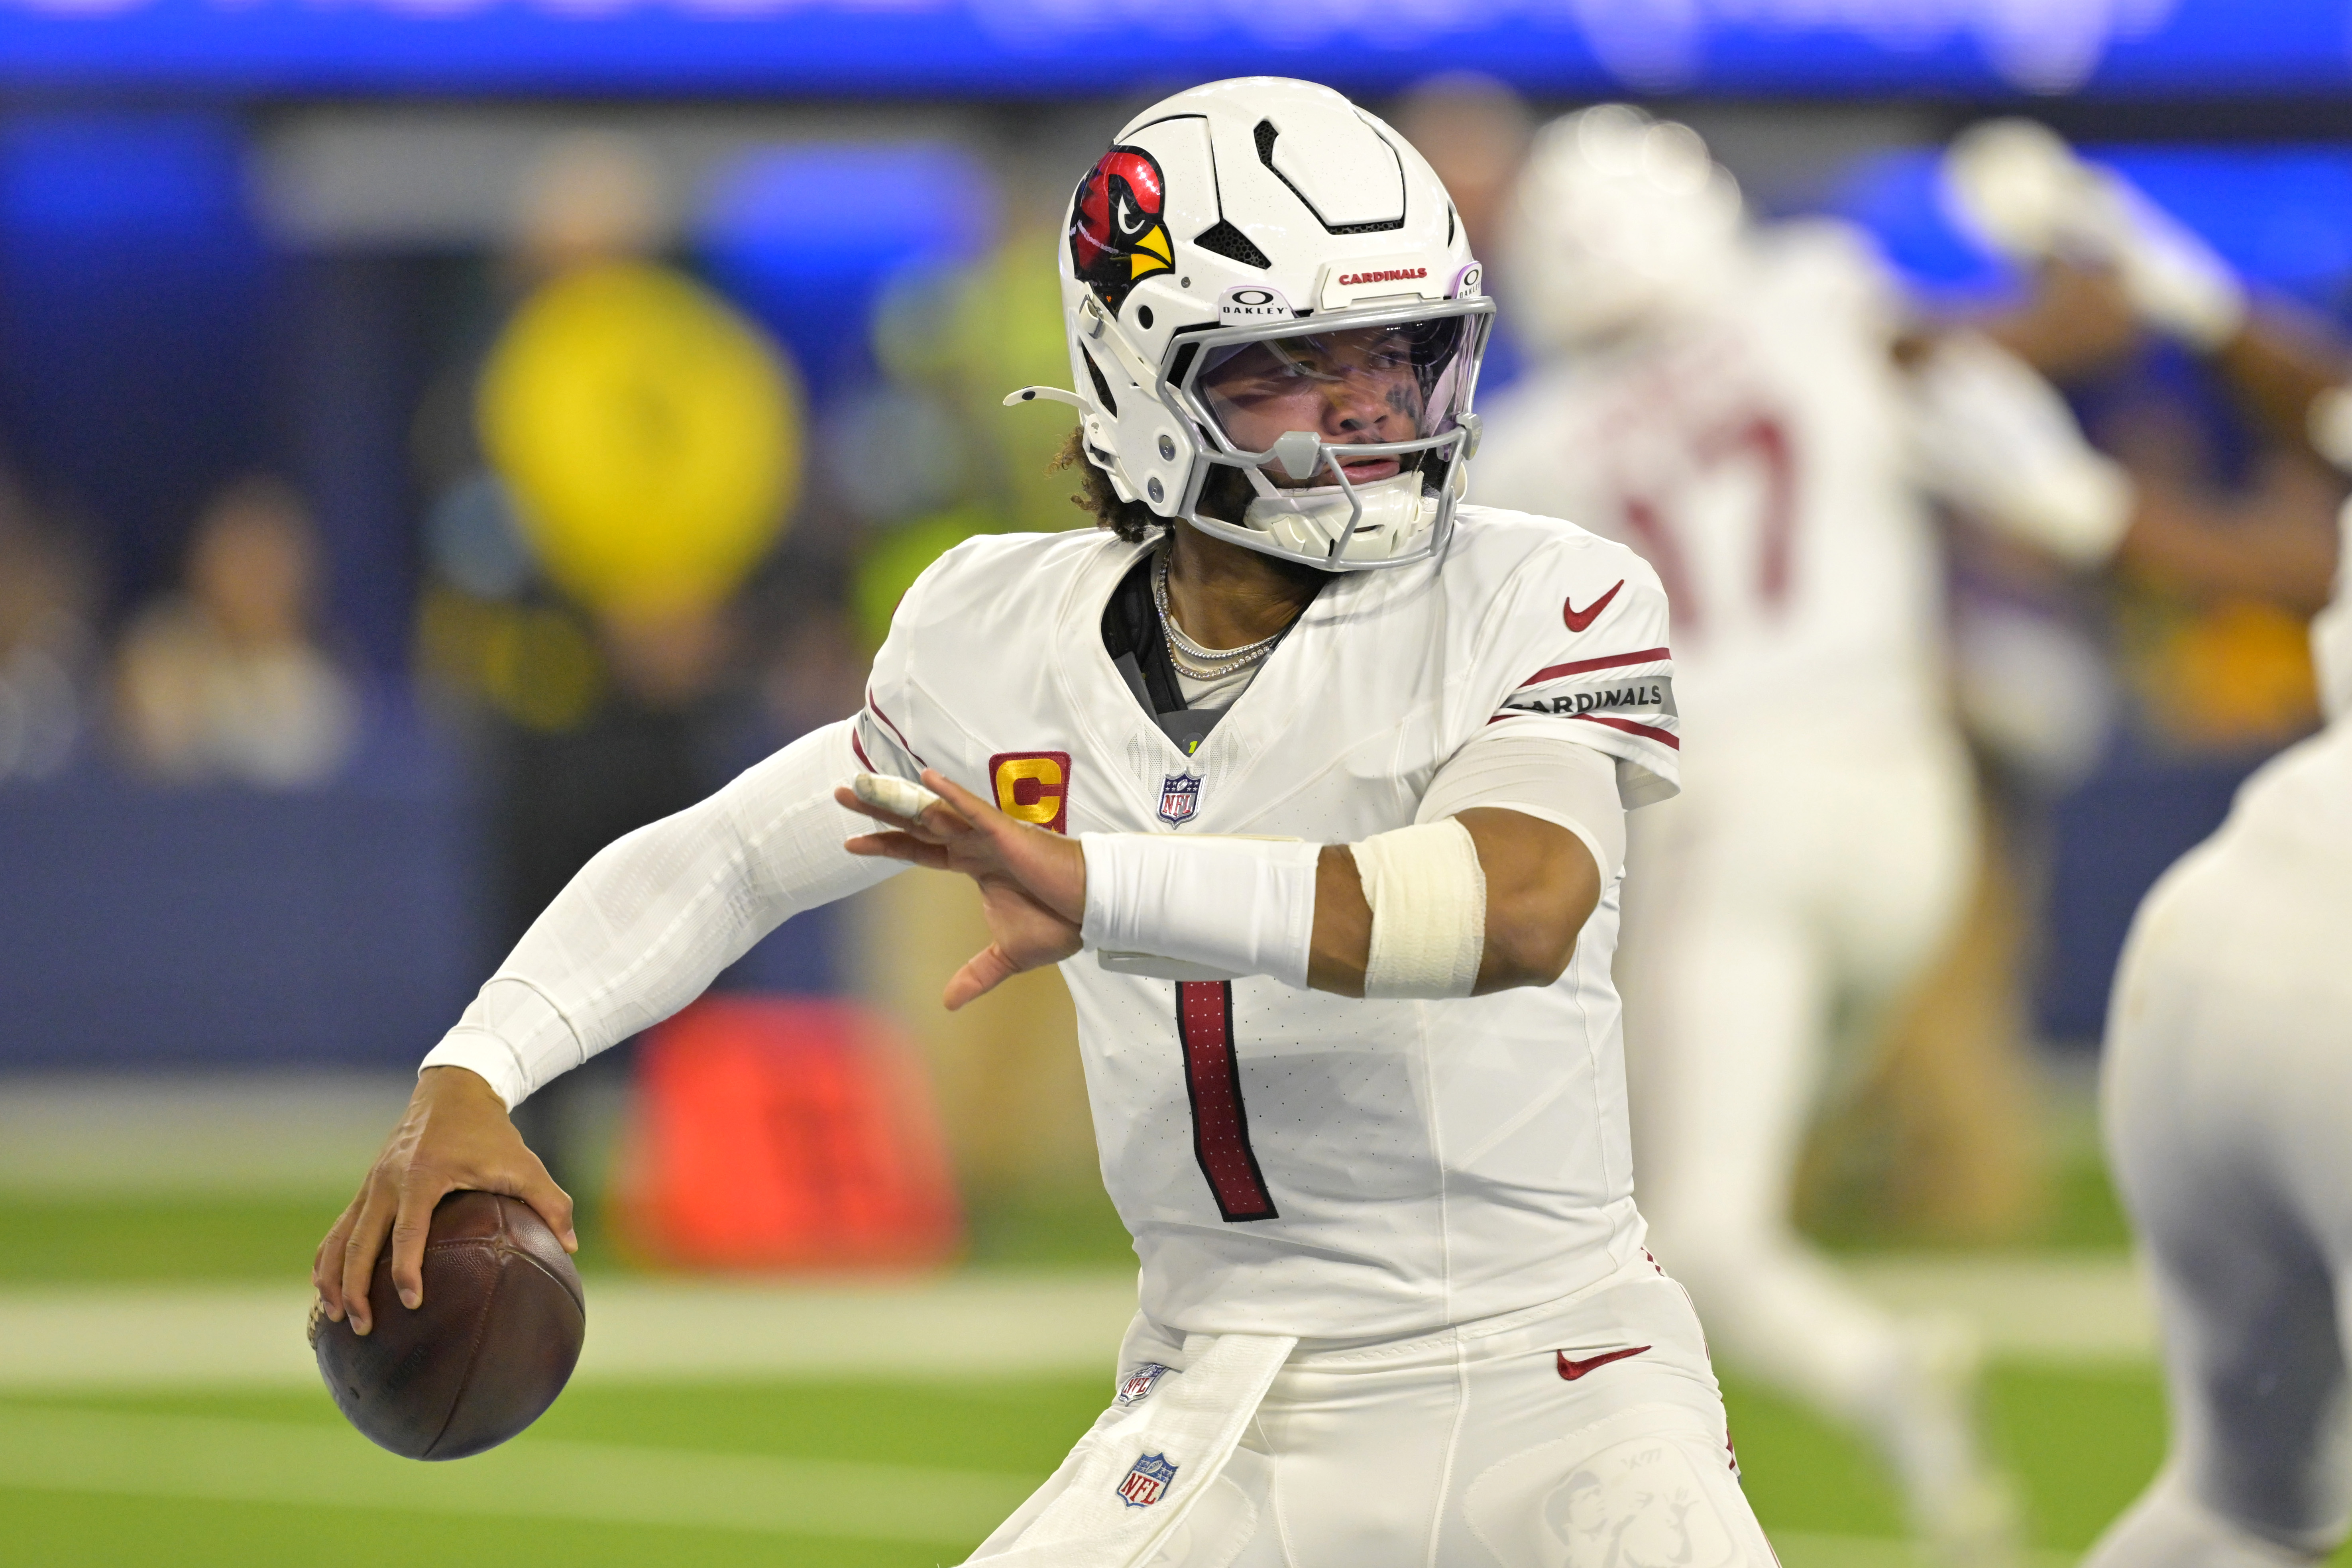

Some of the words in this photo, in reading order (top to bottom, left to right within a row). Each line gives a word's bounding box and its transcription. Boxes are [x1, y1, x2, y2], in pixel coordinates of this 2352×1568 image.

[1339, 267, 1427, 285] CARDINALS
[1460, 281, 1480, 299] OAKLEY
[1188, 741, 1198, 753] 1
[996, 758, 1061, 823] C
[1162, 794, 1193, 817] NFL
[1123, 1377, 1149, 1395] NFL
[1121, 1472, 1160, 1505] NFL
